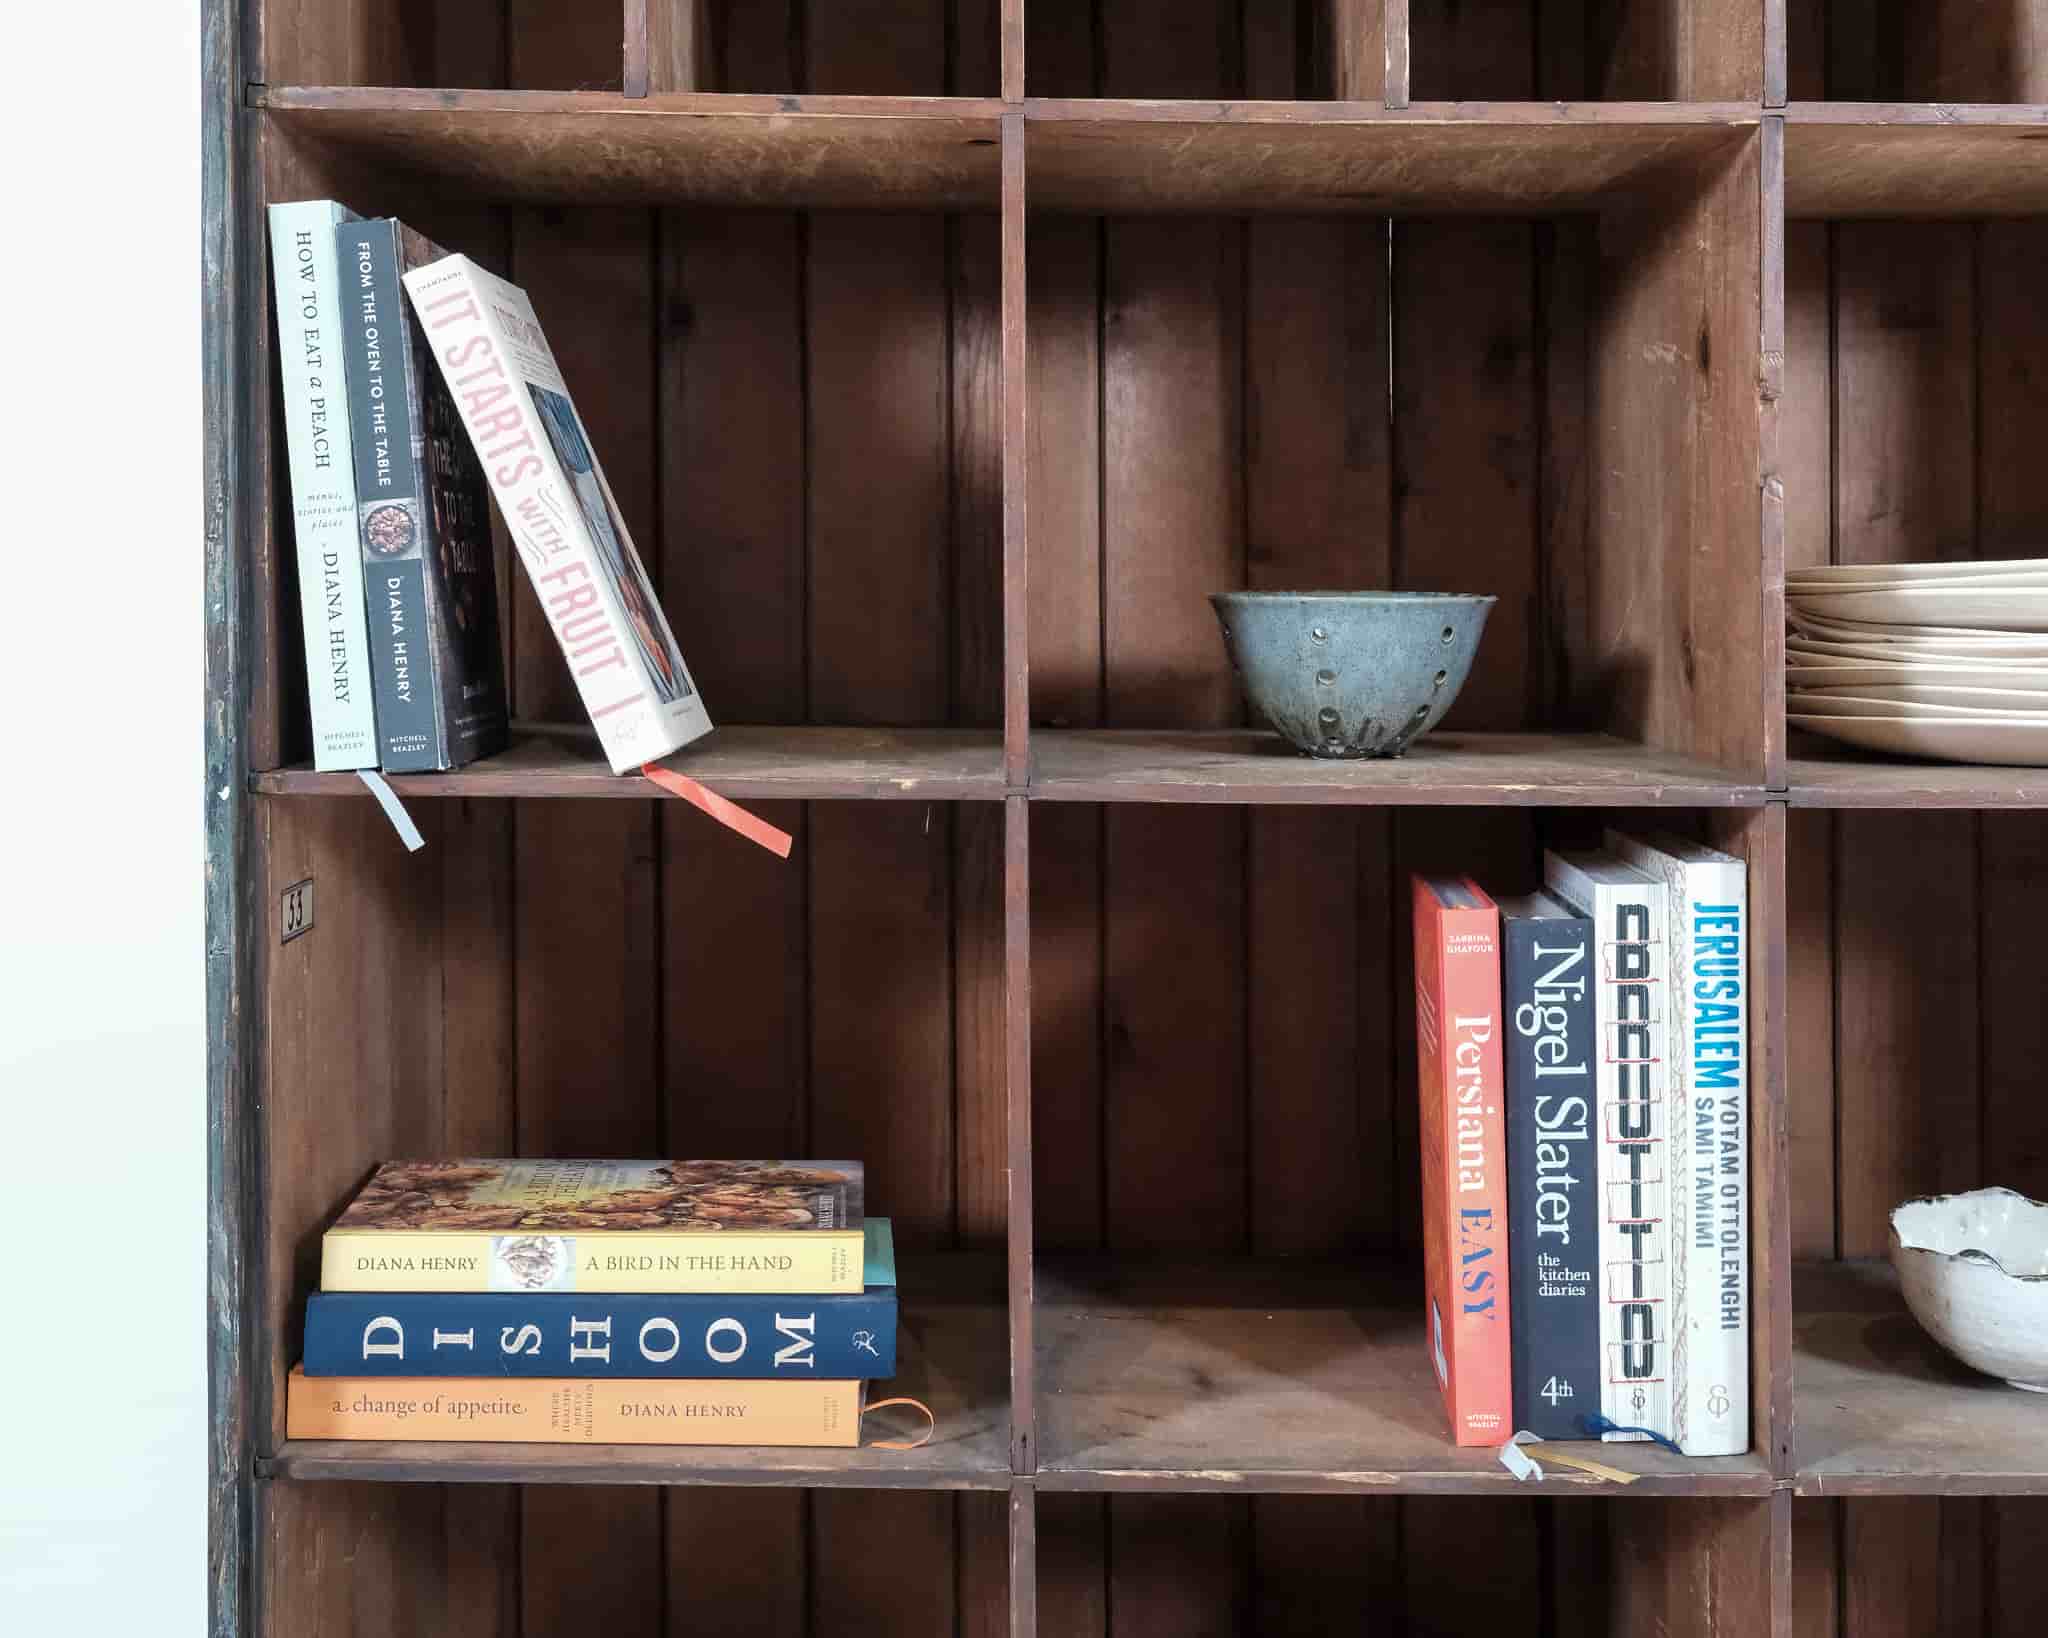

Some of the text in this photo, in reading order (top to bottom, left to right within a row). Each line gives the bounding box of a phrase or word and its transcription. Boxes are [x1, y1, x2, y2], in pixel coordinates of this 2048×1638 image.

[424, 288, 481, 329] IT
[296, 231, 331, 468] HOW TO EAT a PEACH
[357, 239, 392, 487] FROM THE OVEN TO THE TABLE
[445, 335, 544, 488] STARTS
[516, 496, 572, 554] WITH
[322, 551, 350, 704] DIANA HENRY
[387, 576, 411, 703] DIANA HENRY
[539, 560, 628, 677] FRUIT
[390, 734, 428, 744] MITCHELL
[393, 743, 426, 754] BEAZLEY
[1447, 935, 1491, 943] SABRINA
[1447, 943, 1494, 953] GHAYOUR
[1693, 901, 1741, 1089] JERUSALEM
[1515, 940, 1589, 1246] Nigel Slater
[1455, 1014, 1497, 1321] Persiana EASY
[1695, 1096, 1715, 1249] SAMI TAMIMI
[1719, 1095, 1741, 1330] YOTAM OTTOLENGHI
[356, 1256, 480, 1271] DIANA HENRY
[584, 1255, 793, 1271] A BIRD IN THE HAND
[1537, 1252, 1561, 1267] the
[1538, 1267, 1591, 1282] kitchen
[1538, 1281, 1586, 1297] diaries
[363, 1311, 816, 1369] DISHOOM
[352, 1392, 417, 1419] change
[423, 1392, 448, 1414] of
[448, 1395, 528, 1421] appetite
[619, 1404, 746, 1418] DIANA HENRY
[1540, 1376, 1575, 1407] 4th
